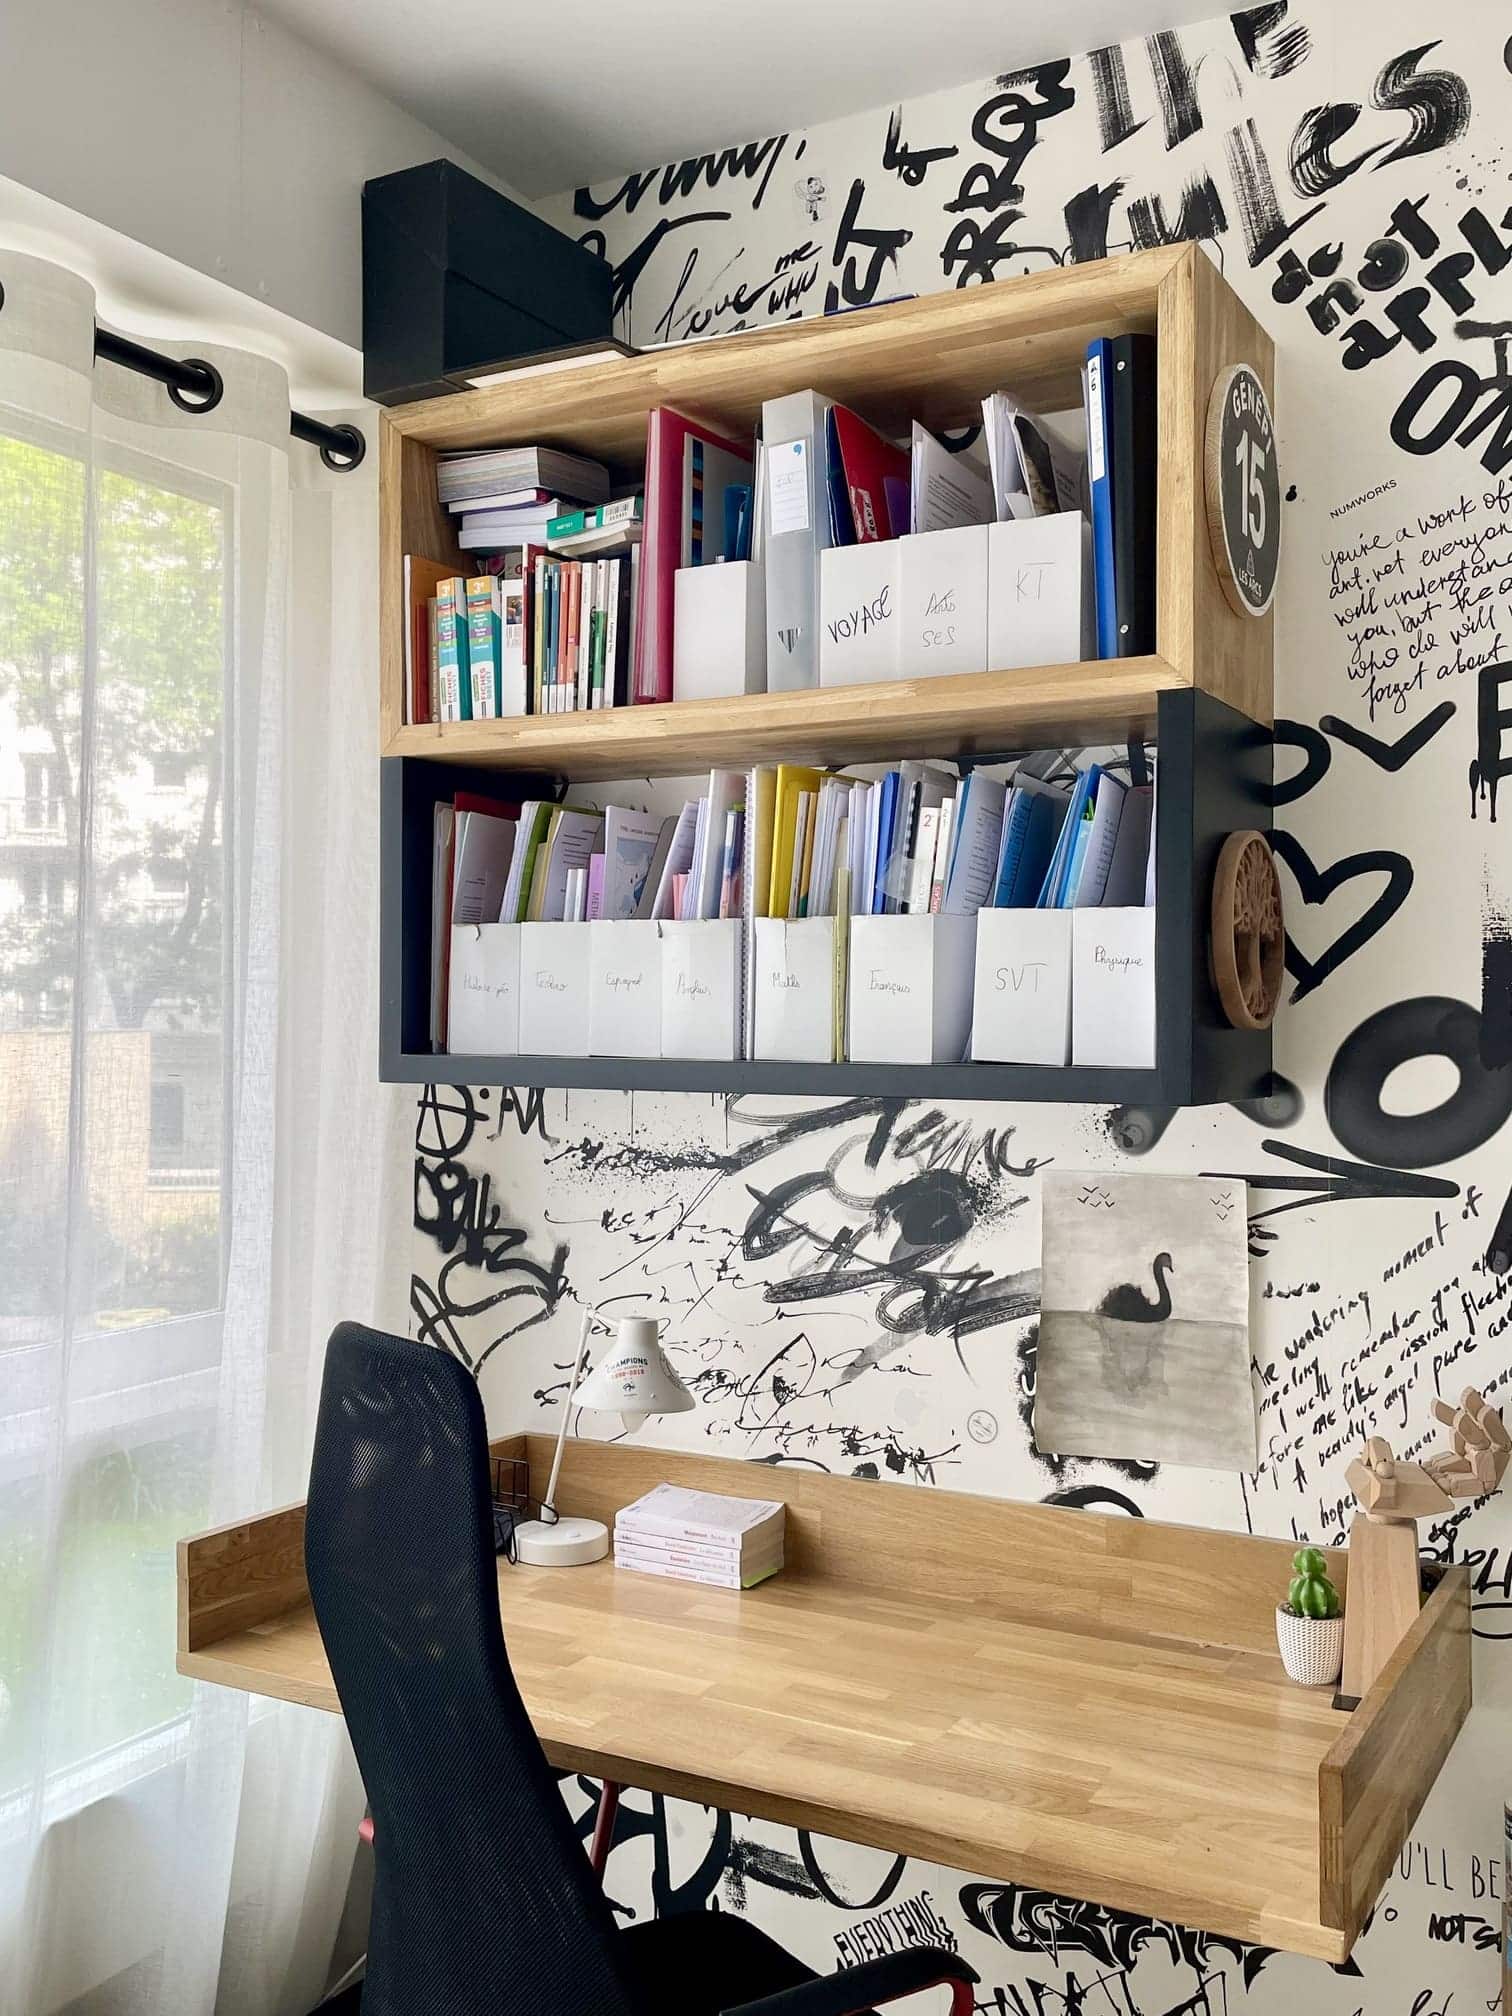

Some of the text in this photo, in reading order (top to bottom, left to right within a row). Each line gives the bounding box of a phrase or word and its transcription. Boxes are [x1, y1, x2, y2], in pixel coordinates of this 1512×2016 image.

[1339, 206, 1512, 371] appl
[1236, 430, 1266, 550] 15
[1330, 479, 1398, 519] NUMWORKS
[1418, 495, 1477, 535] work
[1384, 551, 1512, 609] understan
[1436, 633, 1508, 680] about
[994, 961, 1049, 993] SVT
[1462, 1185, 1483, 1220] of
[1433, 1337, 1478, 1398] pure
[1472, 1855, 1502, 1899] BE
[1428, 1913, 1486, 1943] NOT
